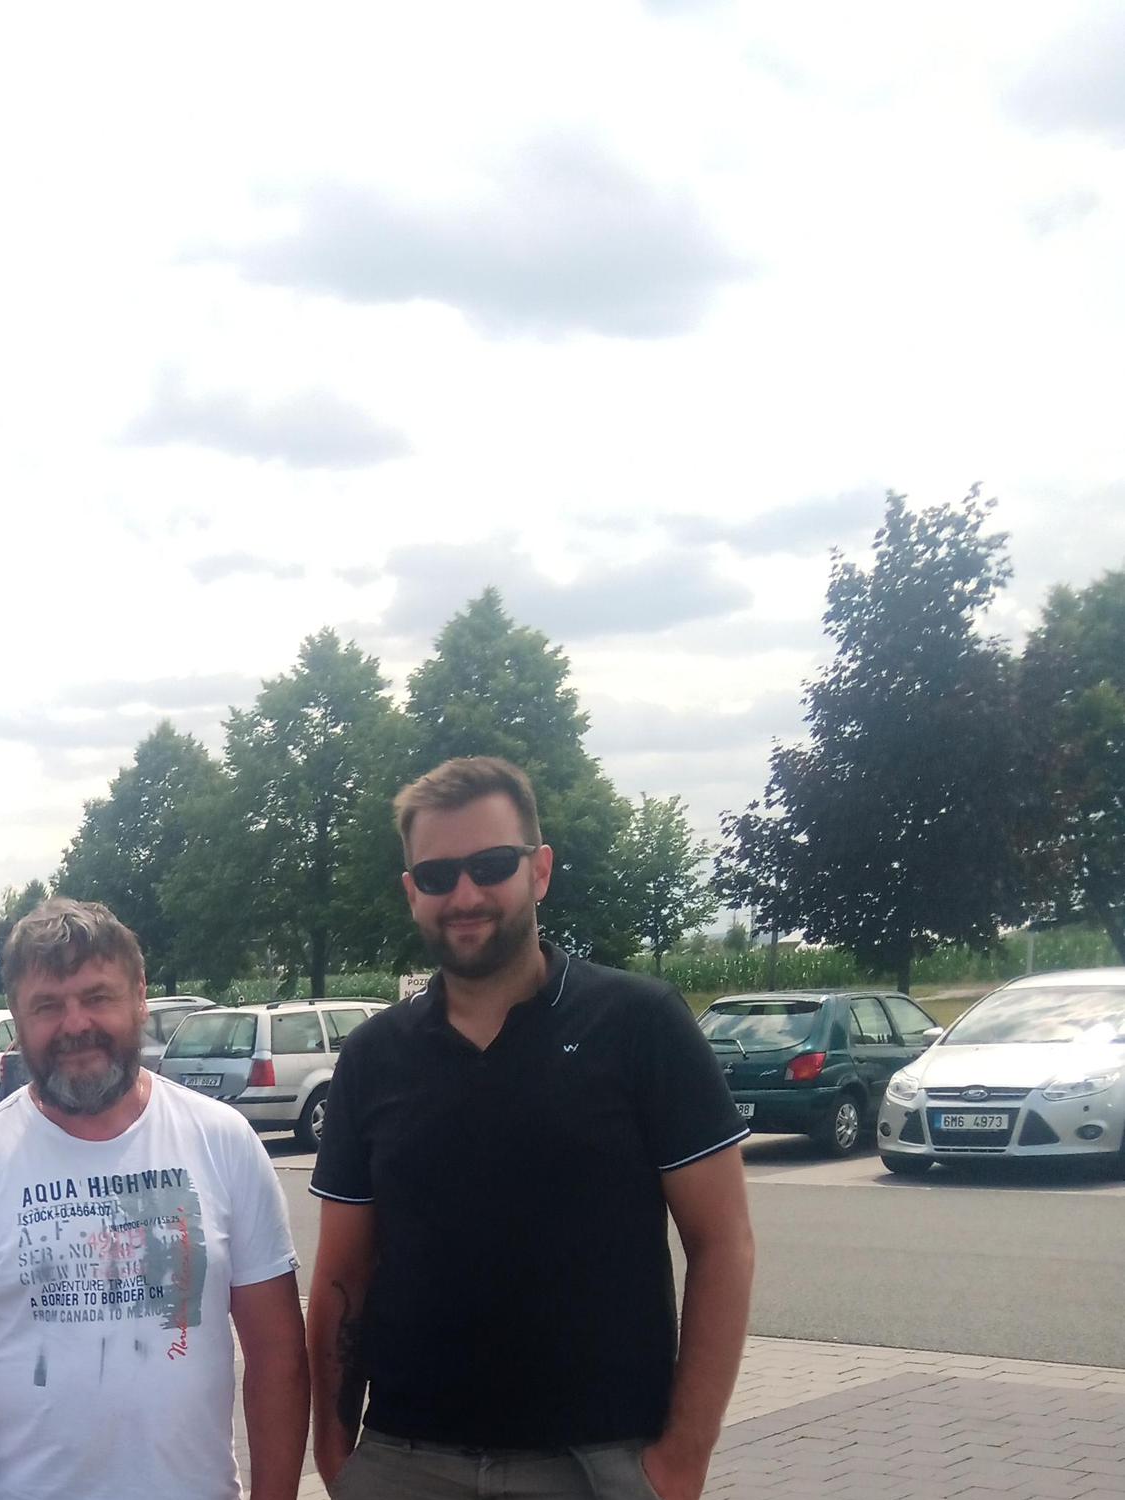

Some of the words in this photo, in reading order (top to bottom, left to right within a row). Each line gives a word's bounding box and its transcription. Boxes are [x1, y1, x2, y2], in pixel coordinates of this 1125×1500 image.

[943, 1116, 964, 1127] 6M6
[973, 1116, 1003, 1127] 4973
[22, 1178, 77, 1207] AQUA
[88, 1168, 183, 1198] HIGHWAY
[42, 1279, 104, 1293] ADVENTURE
[109, 1275, 150, 1290] TRAVEL
[31, 1297, 37, 1308] A
[84, 1293, 96, 1306] TO
[101, 1288, 145, 1305] BORDER
[149, 1286, 164, 1299] CH
[60, 1309, 104, 1323] CANADA
[110, 1308, 122, 1321] TO
